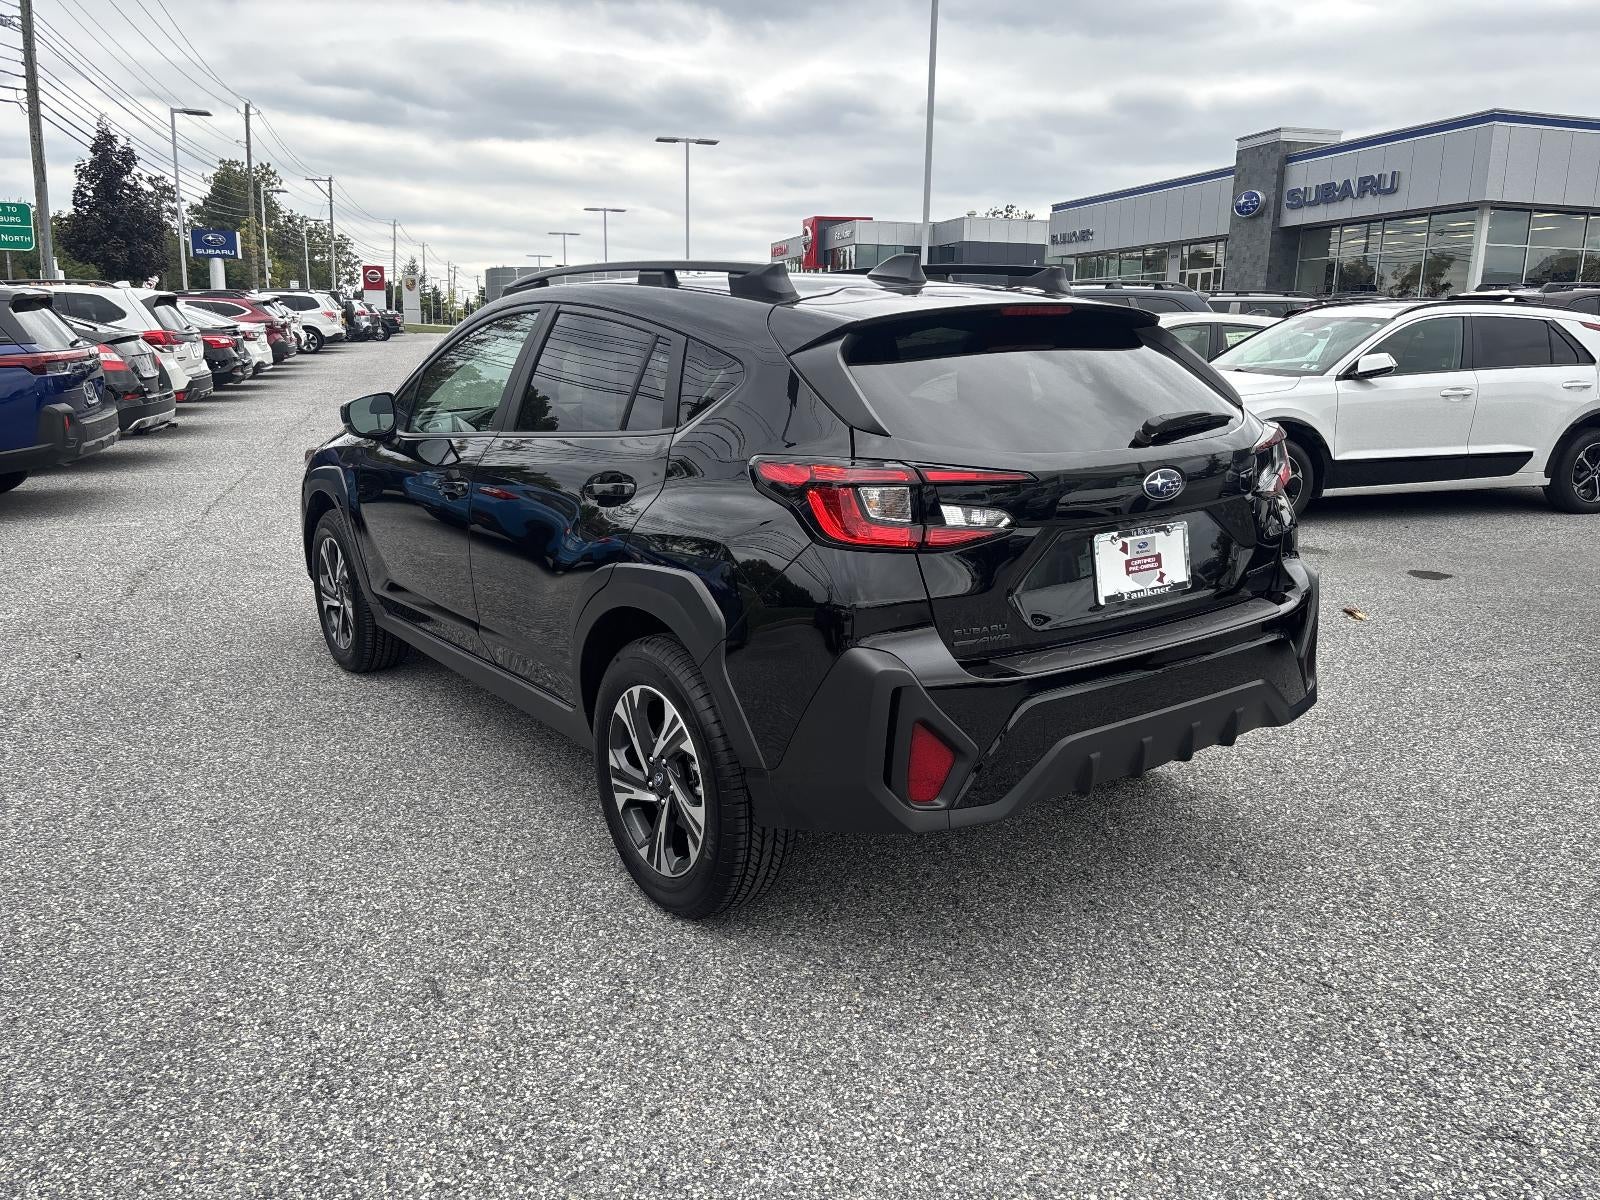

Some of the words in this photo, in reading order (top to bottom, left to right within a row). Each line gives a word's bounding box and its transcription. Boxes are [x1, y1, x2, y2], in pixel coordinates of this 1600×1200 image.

[1286, 171, 1400, 210] SUBARU
[1, 234, 31, 242] NORTH
[195, 248, 235, 256] SUBARU
[1130, 557, 1156, 566] CERTIFIED
[1128, 562, 1159, 572] PRE-OWNED
[1123, 585, 1172, 601] Faulkner
[953, 623, 1008, 635] SUBARU
